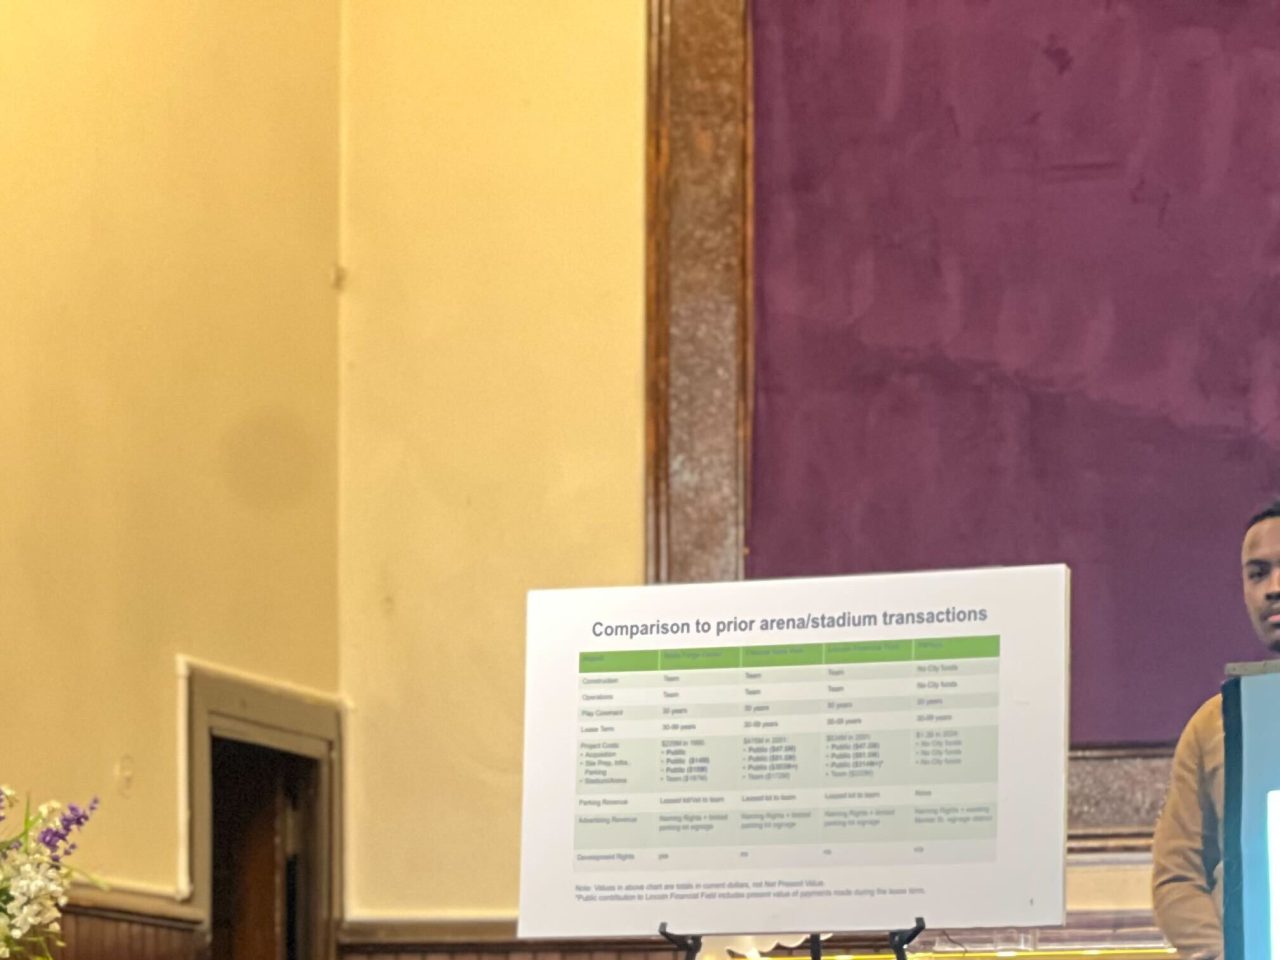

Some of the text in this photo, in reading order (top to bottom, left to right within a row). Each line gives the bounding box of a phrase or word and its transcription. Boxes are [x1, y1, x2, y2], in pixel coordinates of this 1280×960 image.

[592, 605, 988, 640] Comparison to prior arena/stadium transactions
